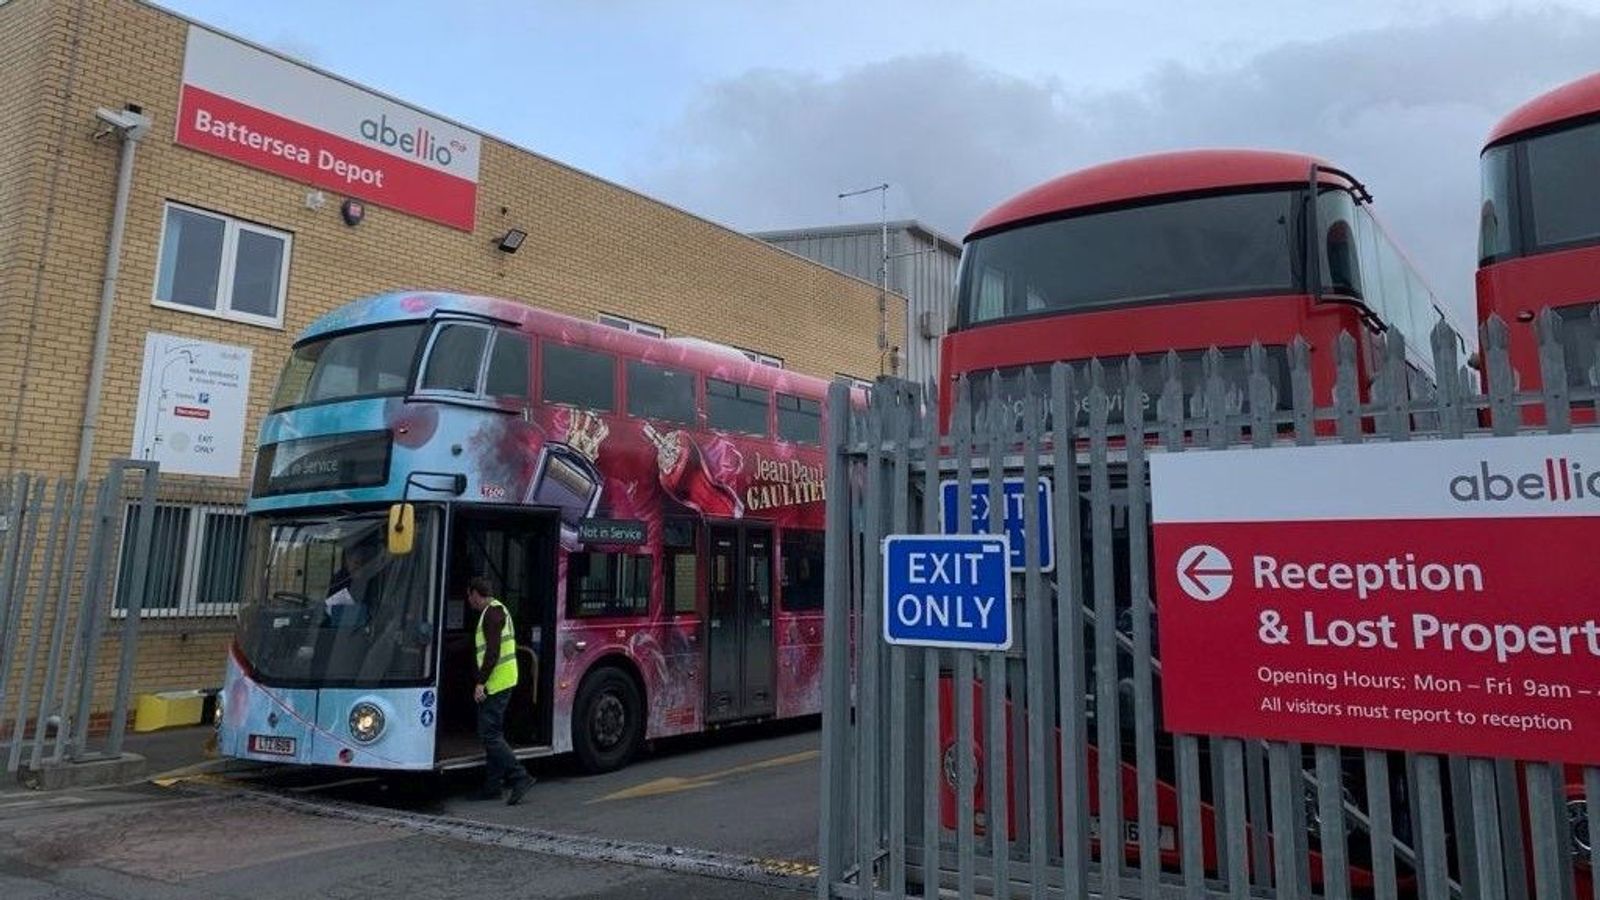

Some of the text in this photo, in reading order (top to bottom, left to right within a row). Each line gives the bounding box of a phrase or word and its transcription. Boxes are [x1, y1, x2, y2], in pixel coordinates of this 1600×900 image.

[195, 108, 385, 189] Battersea Depot
[360, 114, 452, 166] abellio
[753, 452, 824, 484] Jean Paul
[579, 525, 599, 539] Not
[611, 526, 642, 541] Service
[908, 552, 984, 585] EXIT
[1252, 552, 1484, 600] Reception
[897, 593, 995, 629] ONLY
[1257, 609, 1290, 645] &
[1304, 610, 1399, 649] Lost
[1257, 666, 1338, 690] Opening
[1343, 669, 1407, 690] Hours:
[1414, 674, 1462, 693] Mon
[1486, 677, 1513, 695] Fri
[1523, 679, 1572, 698] 9am
[1260, 697, 1573, 732] All visitors must report to reception
